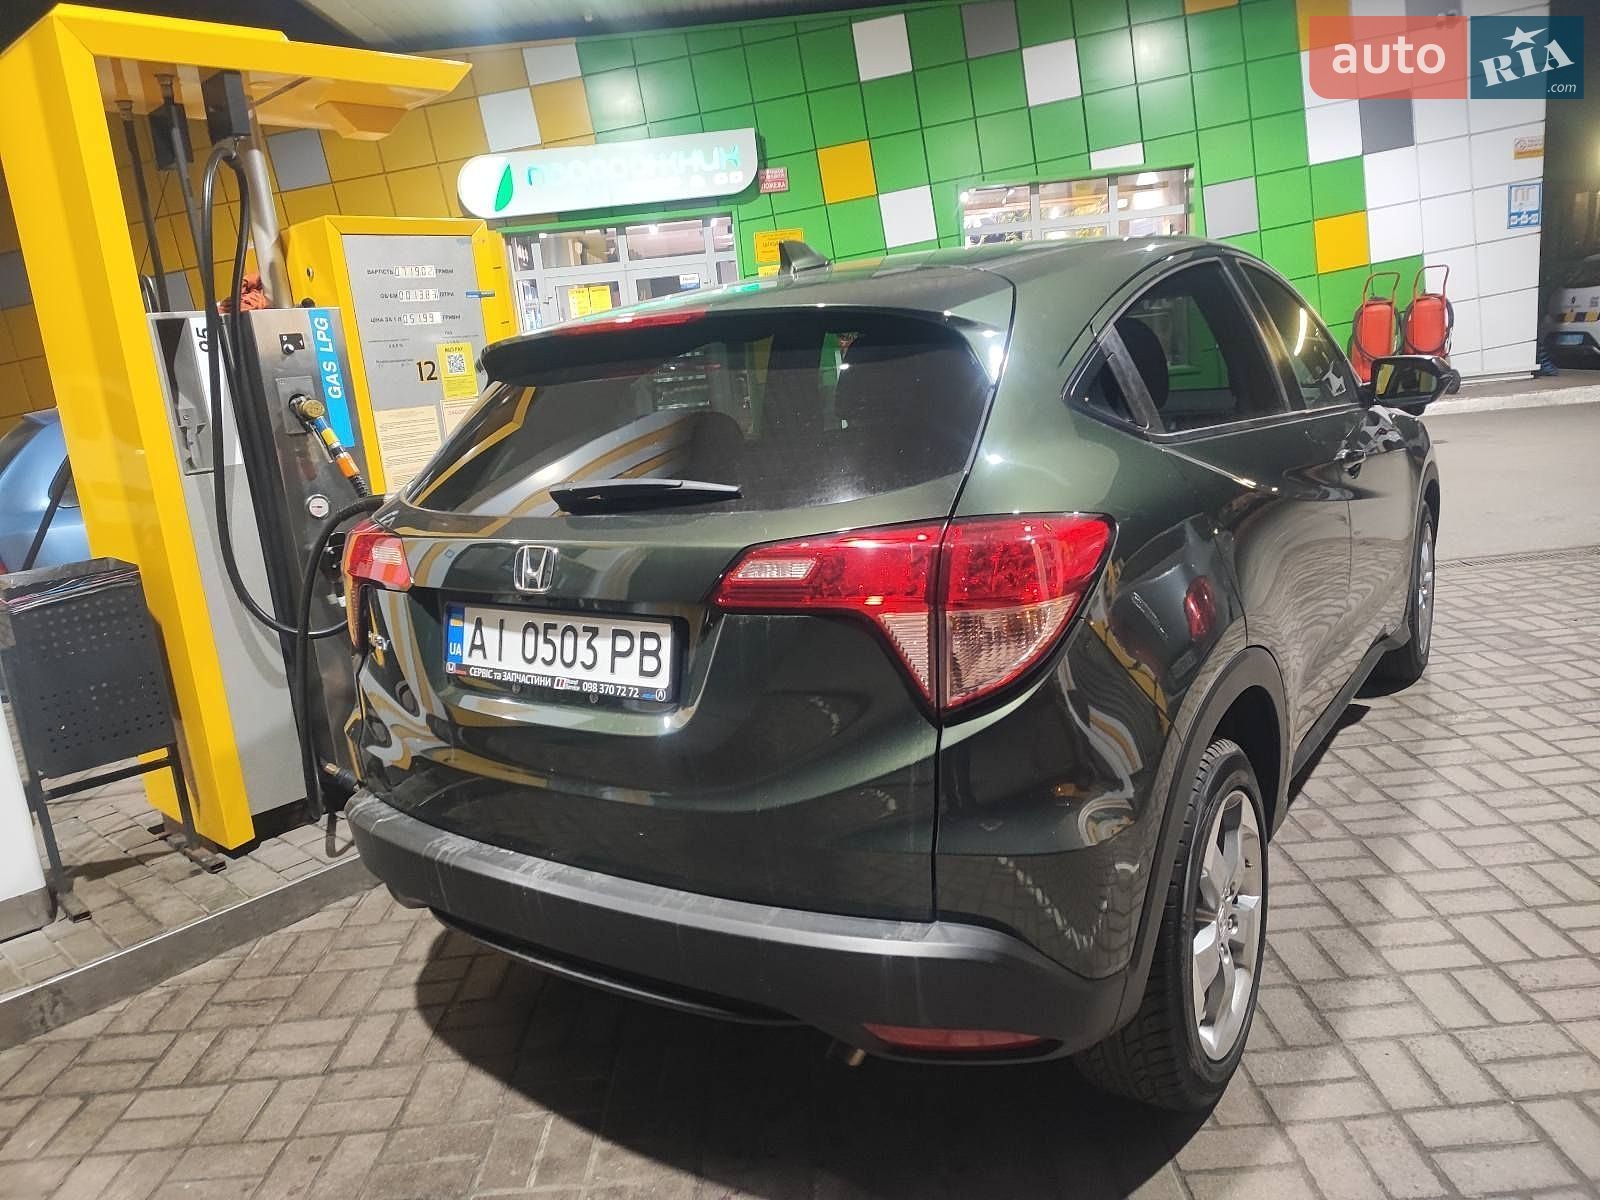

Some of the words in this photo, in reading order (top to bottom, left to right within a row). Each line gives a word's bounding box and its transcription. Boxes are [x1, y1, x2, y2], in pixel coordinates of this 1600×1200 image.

[314, 317, 334, 353] LPG
[322, 361, 342, 399] GAS
[416, 361, 438, 381] 12
[449, 642, 463, 656] UA
[468, 616, 504, 662] AI
[521, 621, 599, 671] 0503
[609, 628, 662, 678] PB
[469, 667, 494, 679] СЕРВІС
[493, 672, 502, 680] та
[502, 671, 552, 687] ЗАПЧАСТИНИ
[582, 681, 598, 692] 098
[599, 683, 614, 695] 370
[616, 685, 627, 696] 72
[628, 687, 640, 698] 72
